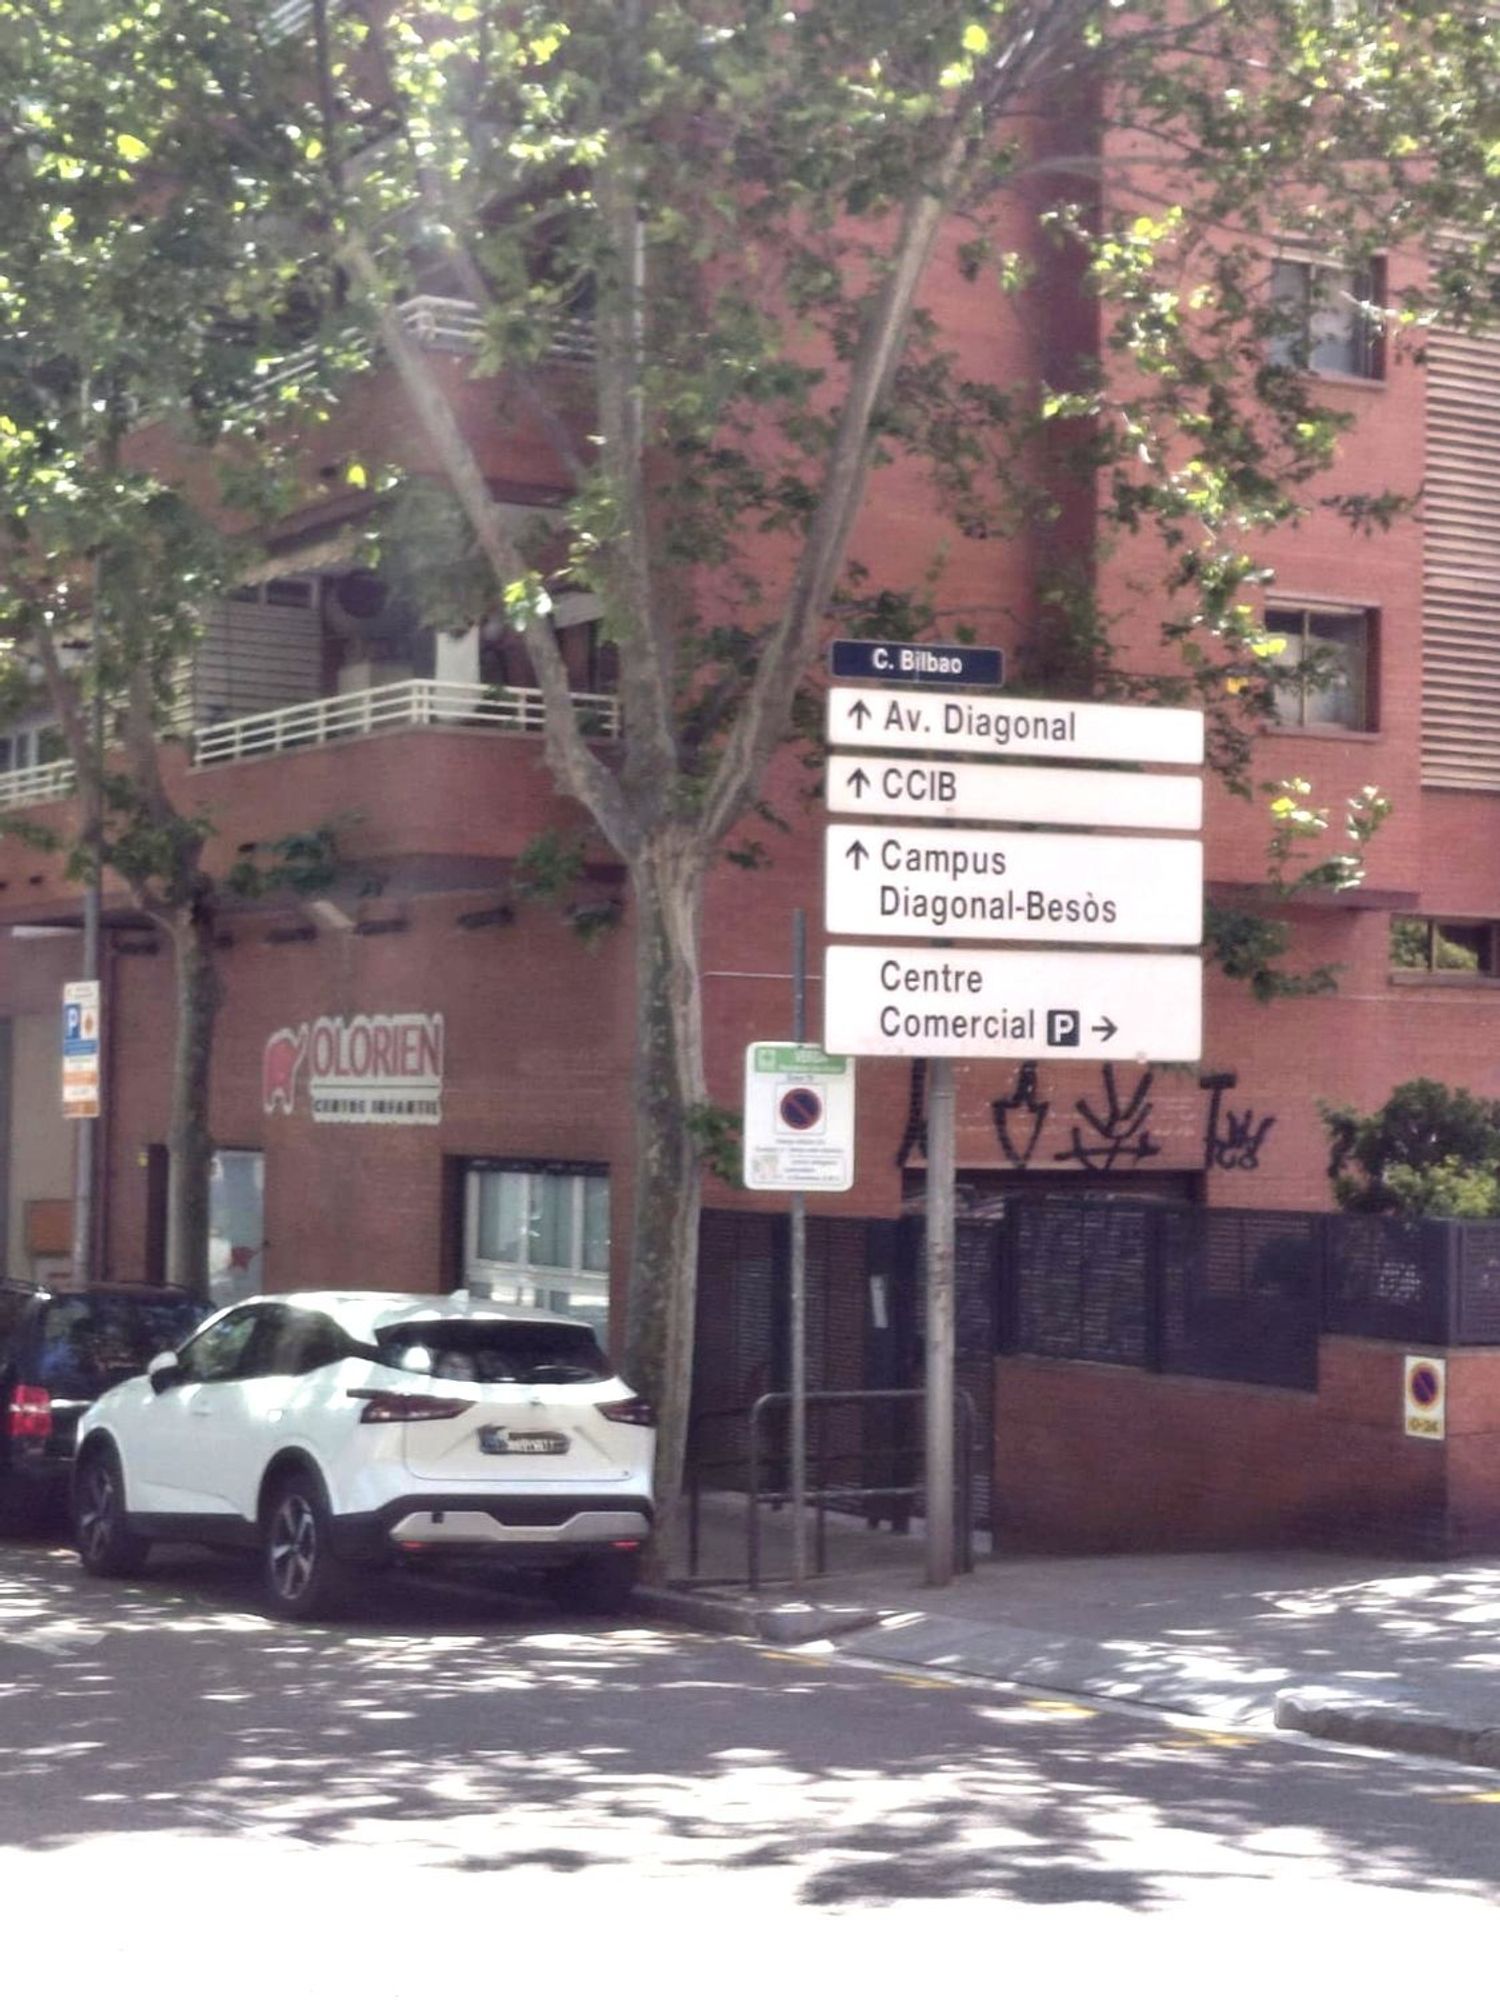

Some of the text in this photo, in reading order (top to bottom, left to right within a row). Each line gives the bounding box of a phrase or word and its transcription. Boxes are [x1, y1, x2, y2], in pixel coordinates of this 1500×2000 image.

[872, 647, 962, 675] C. Bilbao
[884, 700, 1076, 745] Av. Diagonal
[882, 768, 957, 802] CCIB
[881, 839, 1006, 881] Campus
[880, 885, 1117, 926] Diagonal-Besòs
[880, 960, 983, 993] Centre
[879, 1005, 1035, 1040] Comercial
[314, 1023, 443, 1077] OLORIEN
